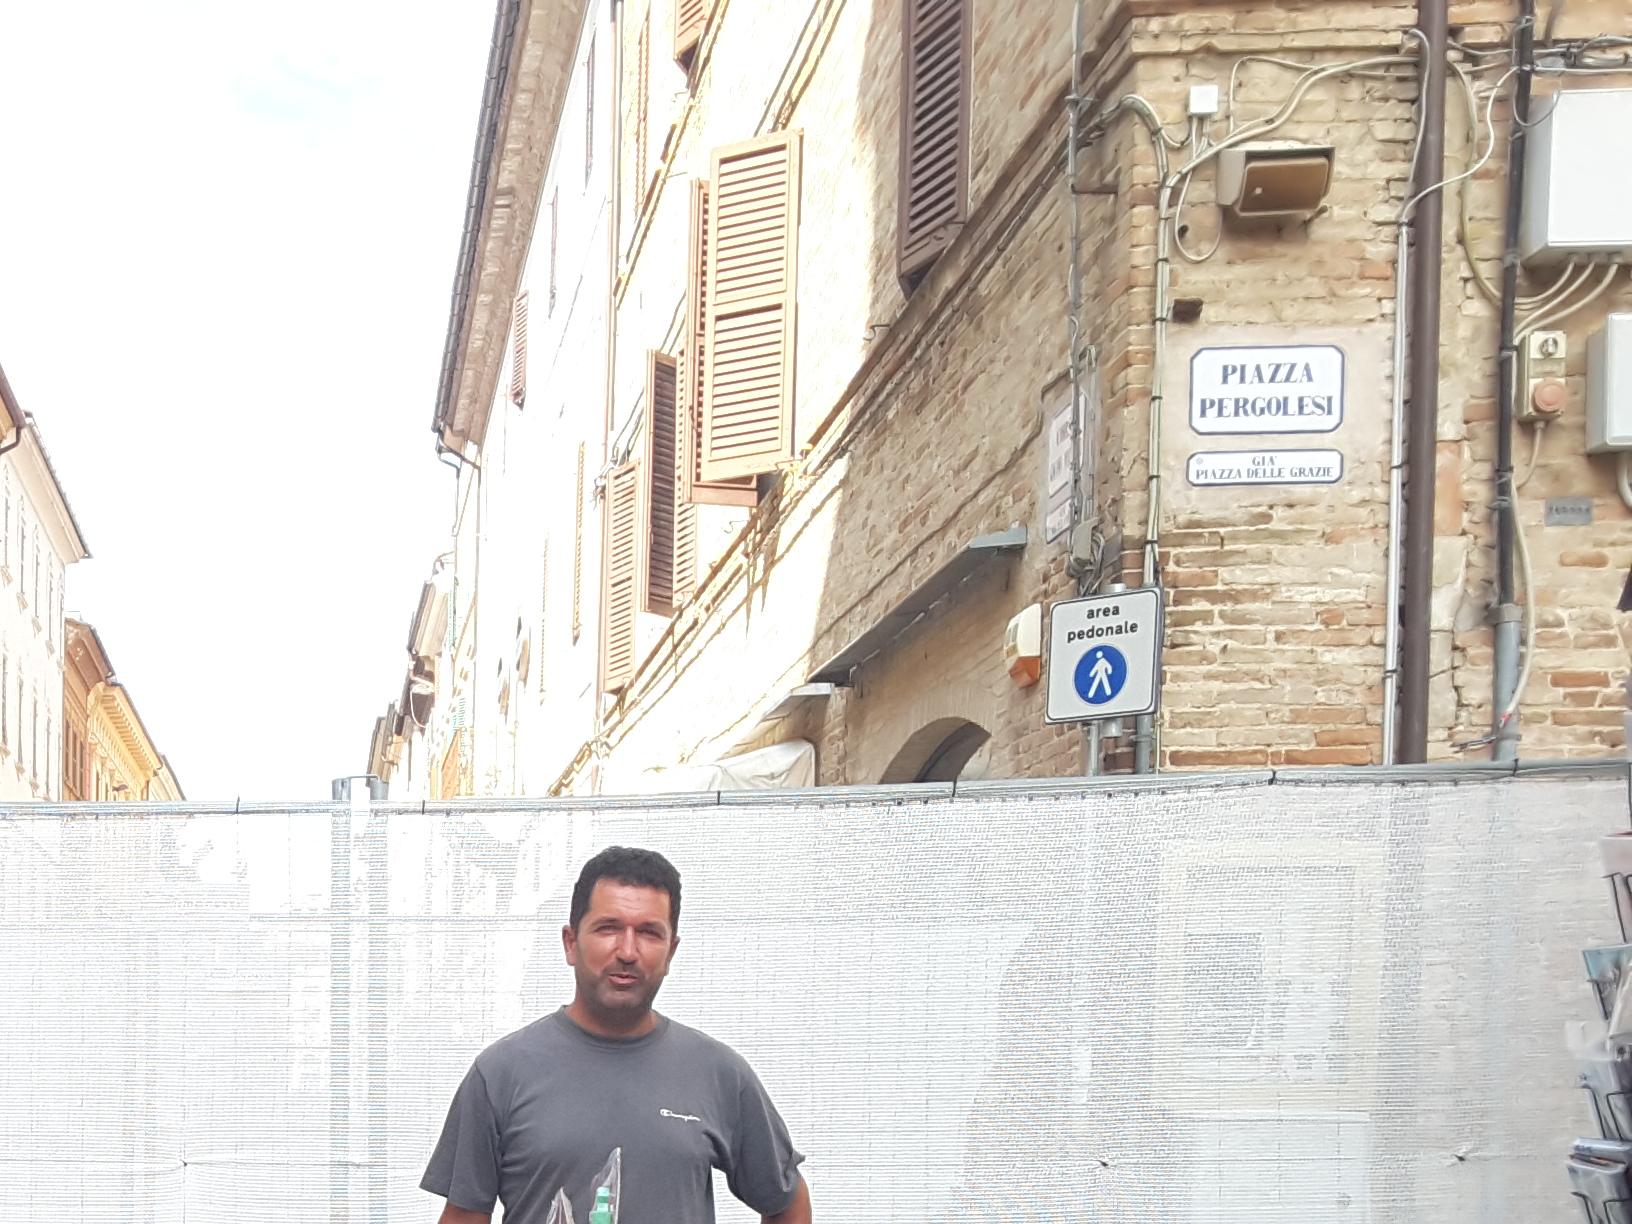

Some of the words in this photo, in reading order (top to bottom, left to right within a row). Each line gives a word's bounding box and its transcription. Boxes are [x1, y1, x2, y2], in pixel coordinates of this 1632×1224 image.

[1220, 362, 1314, 385] PIAZZA
[1199, 395, 1334, 418] PERGOLESI
[1196, 468, 1242, 480] PIAZZA
[1246, 467, 1286, 479] DELLE
[1290, 466, 1334, 478] GRAZIE
[1086, 605, 1120, 619] area
[1067, 620, 1139, 644] pedonale
